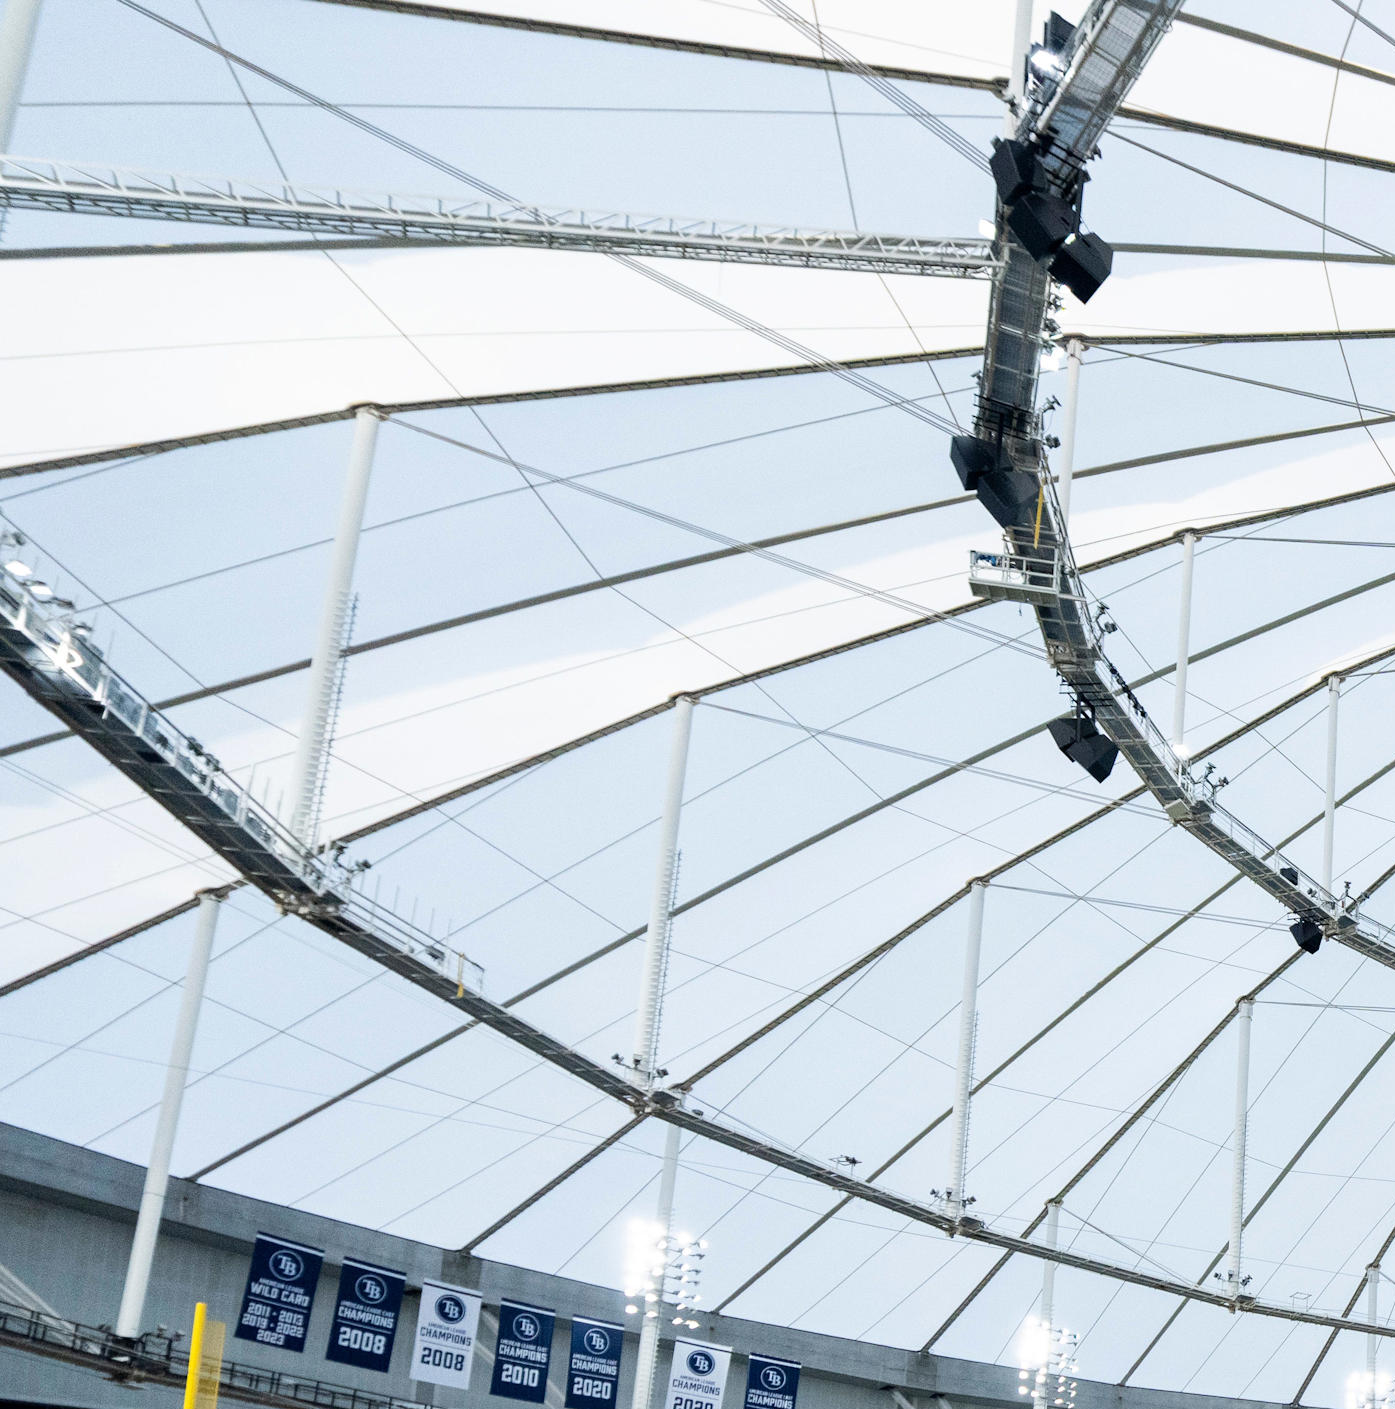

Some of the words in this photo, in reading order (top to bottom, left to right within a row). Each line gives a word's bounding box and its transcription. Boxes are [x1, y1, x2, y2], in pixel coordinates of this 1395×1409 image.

[250, 1282, 278, 1300] WILD
[280, 1289, 311, 1308] CARD
[247, 1303, 270, 1318] 2011
[337, 1307, 394, 1329] CHAMPIONS
[256, 1330, 285, 1346] 2023
[337, 1327, 387, 1355] 2008
[420, 1326, 472, 1347] CHAMPIONS
[420, 1347, 465, 1371] 2008
[499, 1344, 547, 1363] CHAMPIONS
[501, 1364, 540, 1387] 2010
[572, 1359, 617, 1376] CHAMPIONS
[572, 1377, 612, 1400] 2020
[672, 1378, 720, 1396] CHAMPIONS
[747, 1394, 792, 1409] CHAMPIONS
